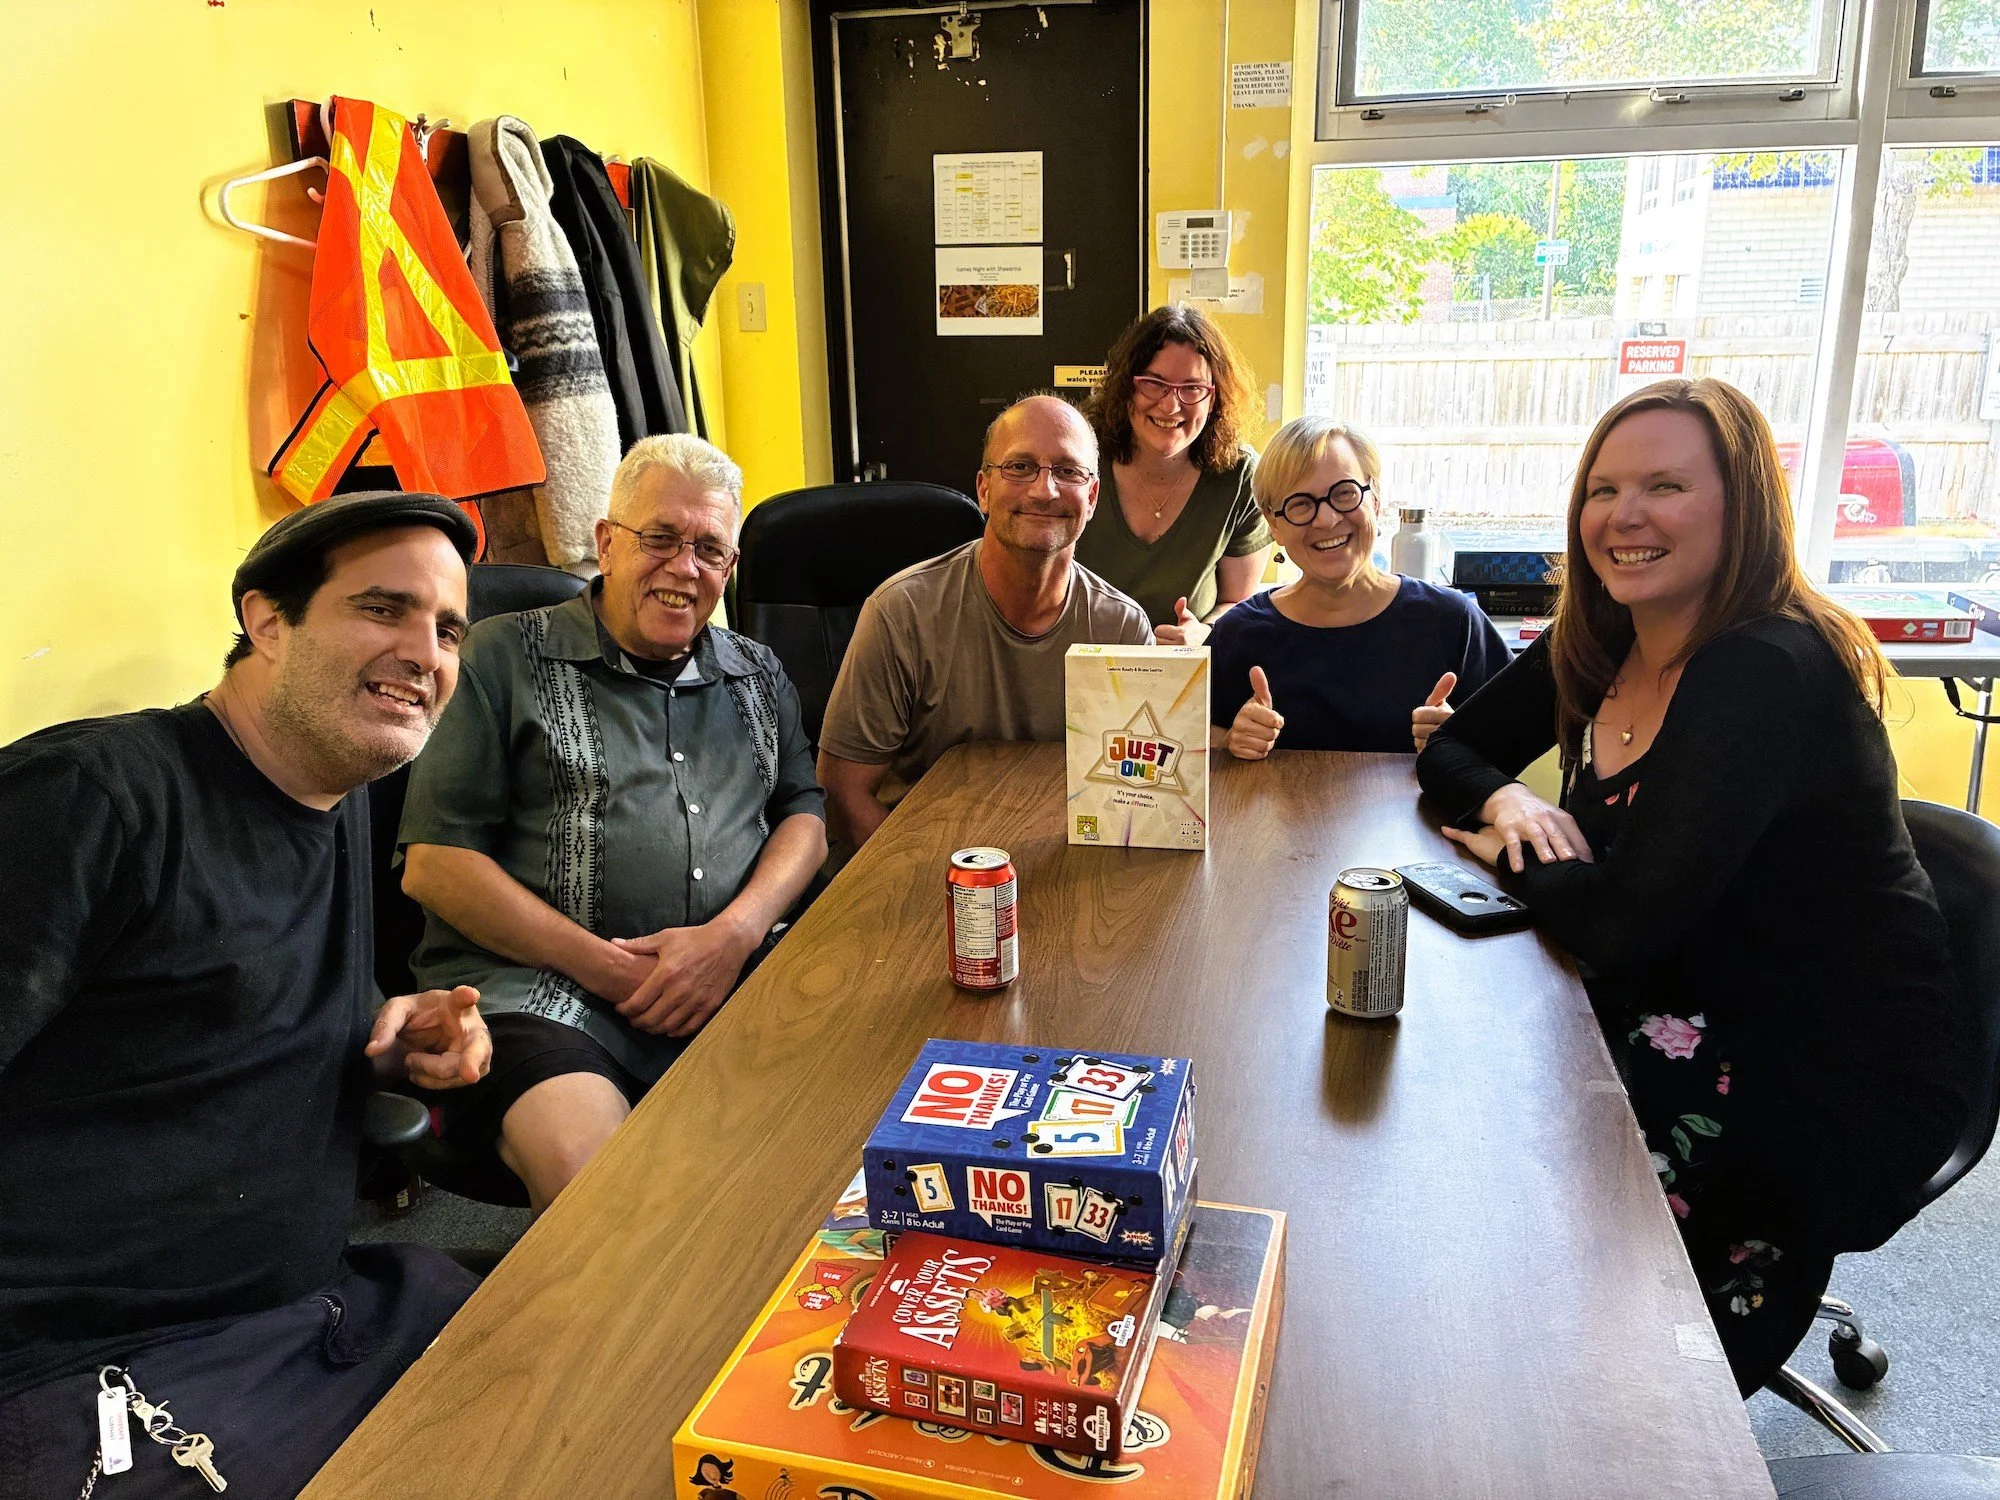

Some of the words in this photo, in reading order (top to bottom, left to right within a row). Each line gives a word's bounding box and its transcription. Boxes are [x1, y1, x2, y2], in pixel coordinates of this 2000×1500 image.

[1626, 345, 1680, 358] RESERVED
[1628, 360, 1675, 373] PARKING
[1110, 737, 1175, 767] JUST
[1121, 760, 1157, 781] ONE
[1331, 892, 1350, 909] Diet
[1020, 1073, 1034, 1083] Pay
[1078, 1068, 1126, 1092] 33
[910, 1071, 983, 1121] NO
[1013, 1087, 1027, 1098] Play
[1026, 1083, 1040, 1097] Game
[967, 1073, 1010, 1125] THANKS!
[1009, 1097, 1021, 1107] The
[1021, 1096, 1034, 1108] Card
[1071, 1098, 1115, 1115] 17
[1054, 1132, 1100, 1144] 5
[1145, 1128, 1157, 1141] Adult
[1132, 1154, 1143, 1165] 3-7
[924, 1178, 937, 1200] 5
[973, 1170, 1025, 1202] NO
[972, 1200, 1028, 1215] THANKS!
[1056, 1198, 1072, 1220] 17
[881, 1210, 898, 1220] 3-7
[1083, 1203, 1109, 1228] 33
[907, 1218, 912, 1226] 8
[922, 1220, 945, 1229] Adult
[1005, 1219, 1016, 1227] Play
[1022, 1221, 1032, 1229] Pay
[823, 1272, 841, 1280] 2010
[893, 1287, 926, 1324] COVER
[912, 1259, 942, 1285] YOUR
[804, 1302, 823, 1310] Spiel
[1053, 1402, 1062, 1420] 7-99
